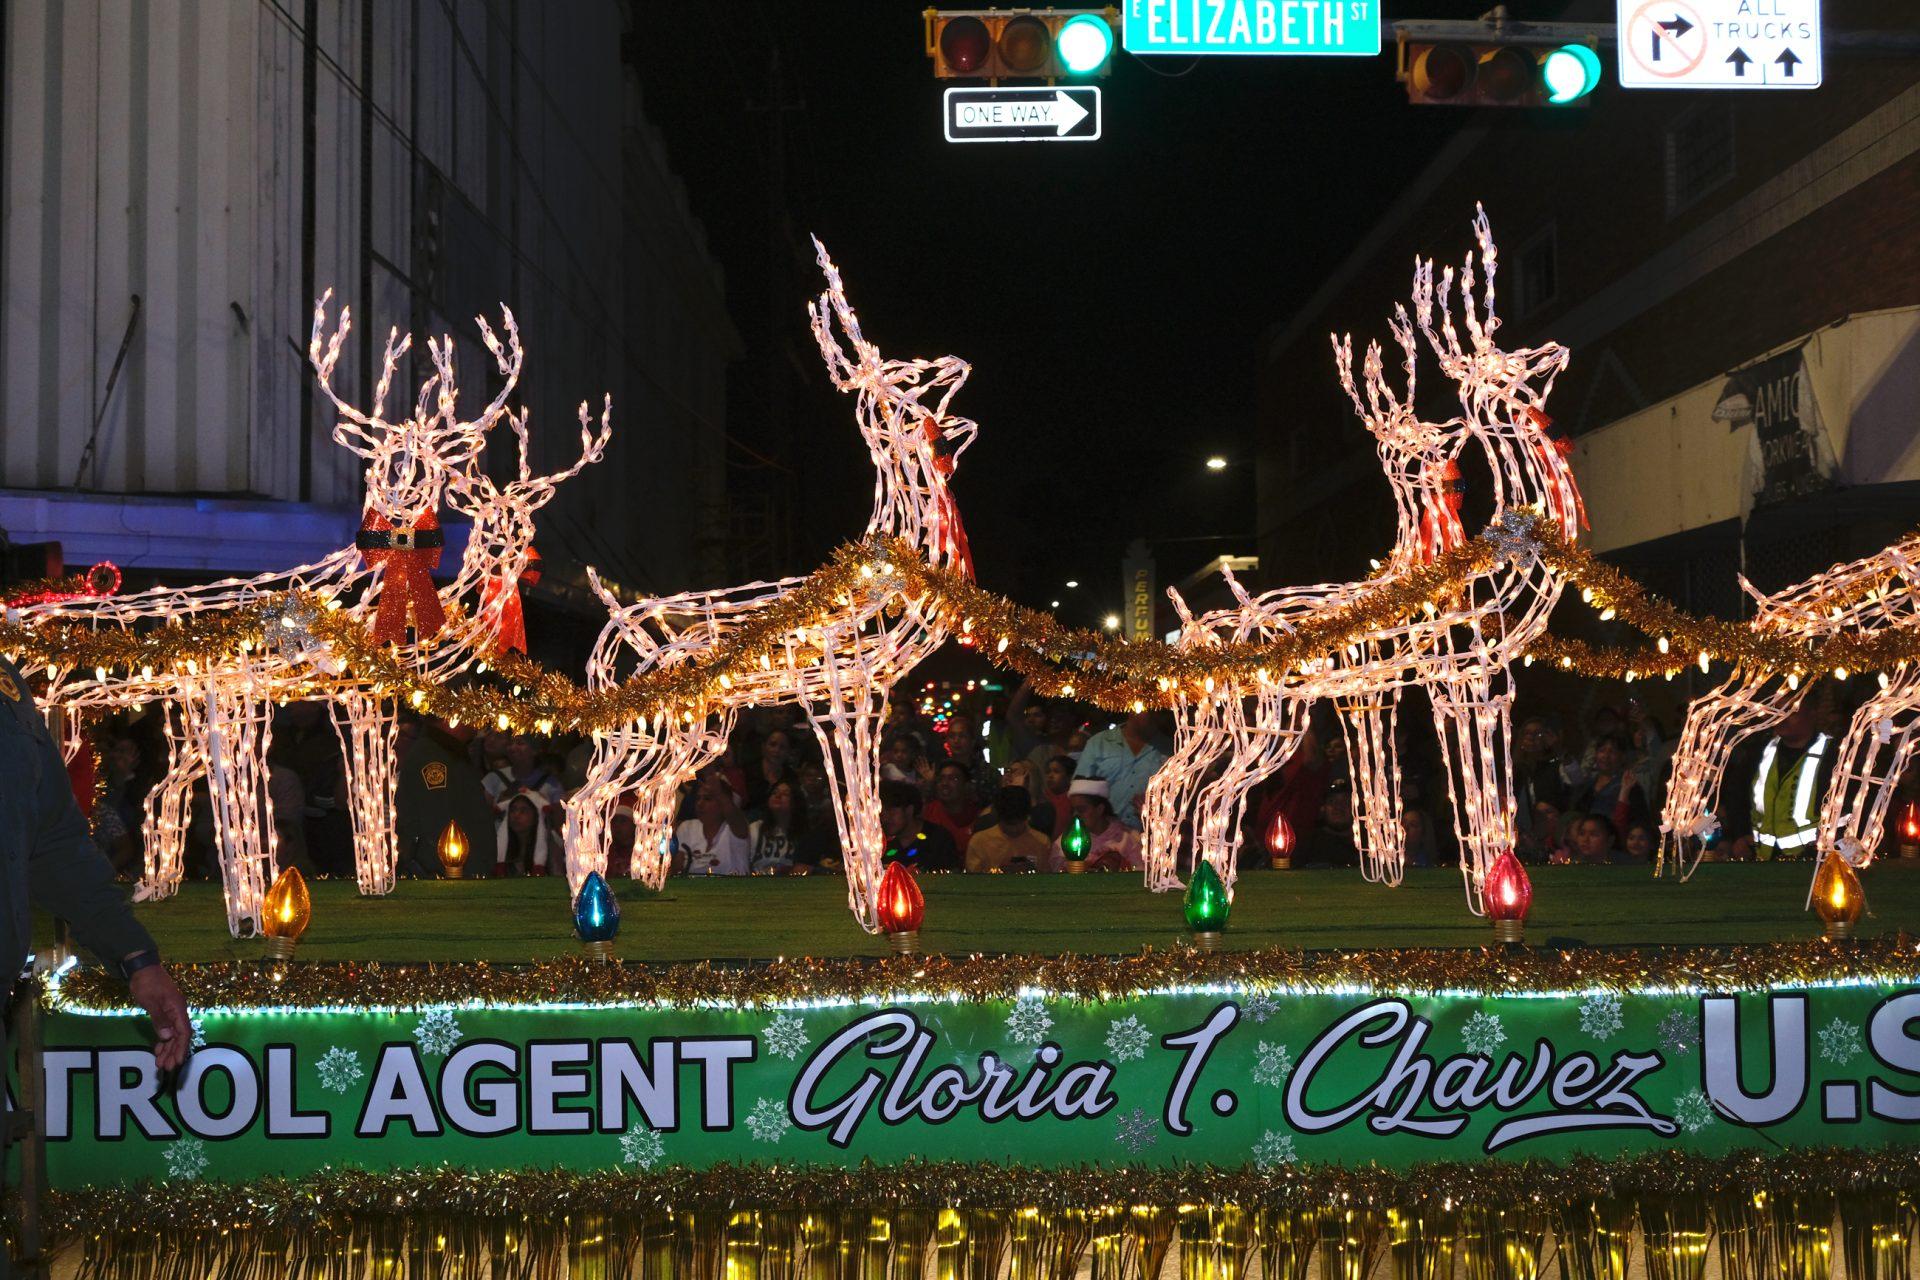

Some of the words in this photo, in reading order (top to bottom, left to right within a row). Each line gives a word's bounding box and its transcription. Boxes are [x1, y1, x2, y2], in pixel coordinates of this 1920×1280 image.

[1737, 0, 1786, 16] ALL
[1132, 0, 1142, 18] E
[1148, 0, 1344, 45] ELIZABETH
[1351, 2, 1368, 21] ST
[1713, 22, 1811, 39] TRUCKS
[963, 106, 1002, 124] ONE
[1010, 105, 1051, 123] WAY
[354, 1036, 757, 1138] AGENT
[788, 1006, 1118, 1149] Gloria
[1281, 994, 1681, 1155] Chavez
